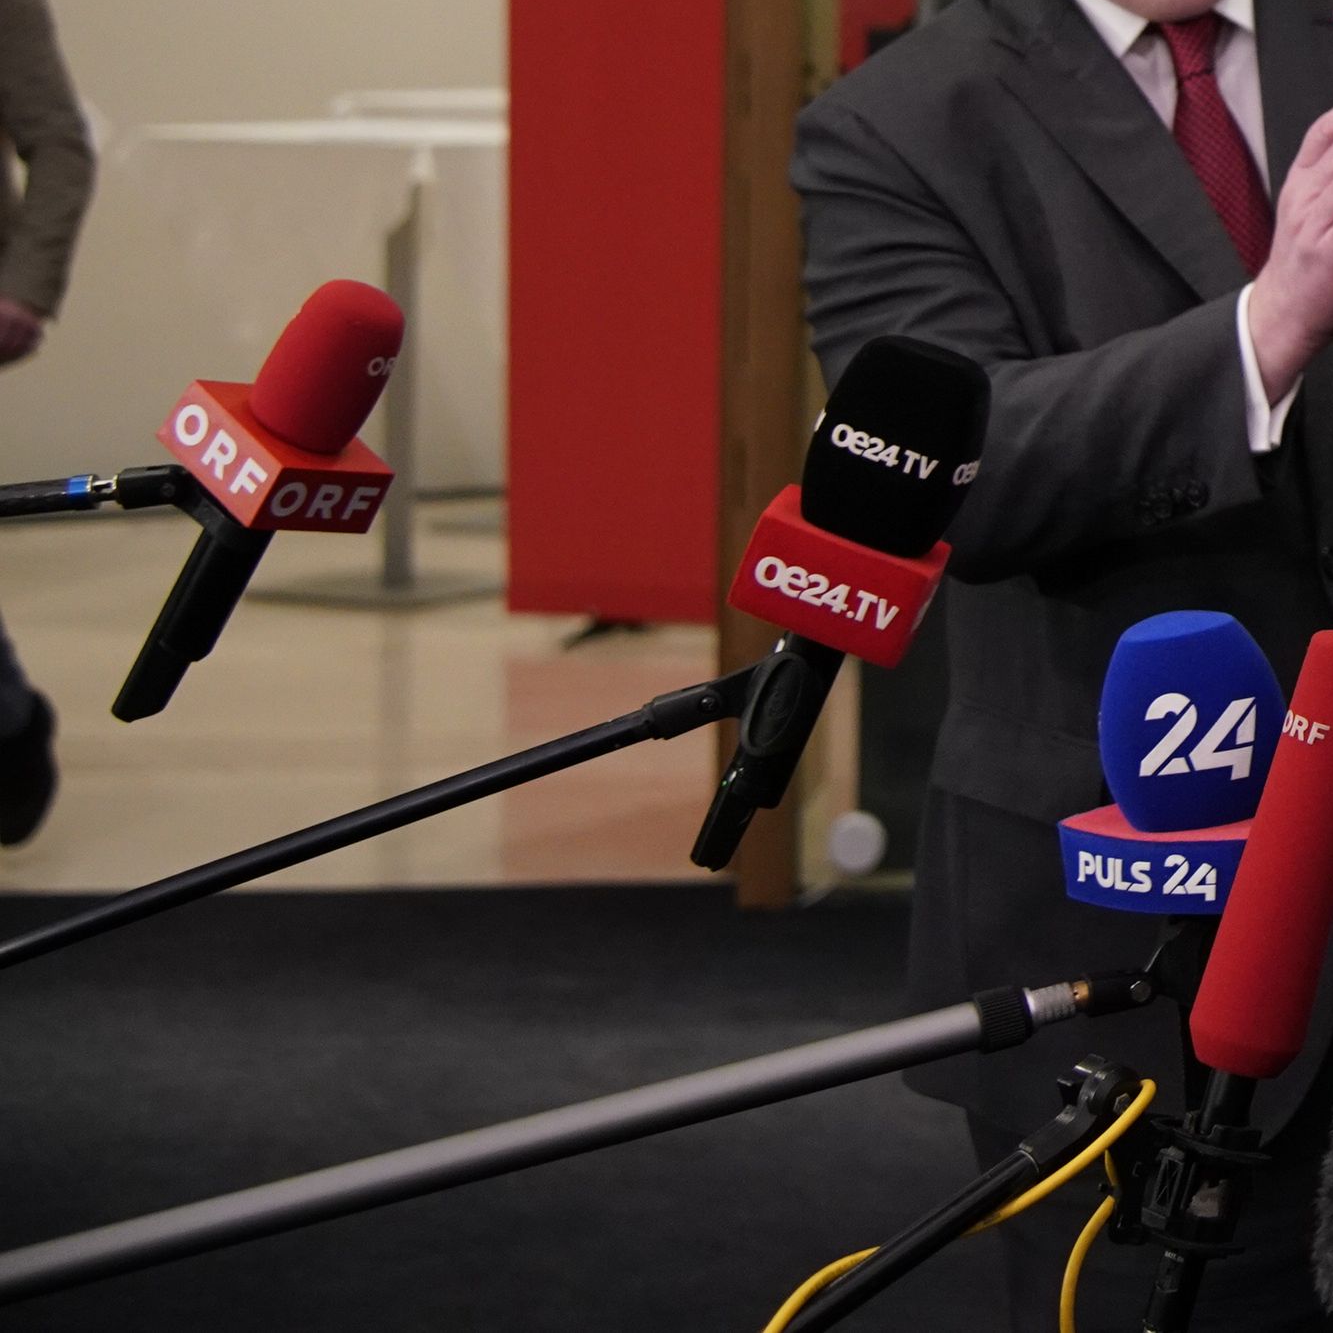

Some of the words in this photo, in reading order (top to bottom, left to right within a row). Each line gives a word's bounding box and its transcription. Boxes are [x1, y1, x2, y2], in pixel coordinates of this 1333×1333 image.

[367, 356, 397, 377] OR
[175, 404, 268, 496] ORF
[271, 482, 380, 520] ORF
[1139, 692, 1256, 781] 24
[1282, 709, 1331, 745] ORF
[1077, 851, 1152, 893] PULS
[1162, 854, 1217, 901] 24
